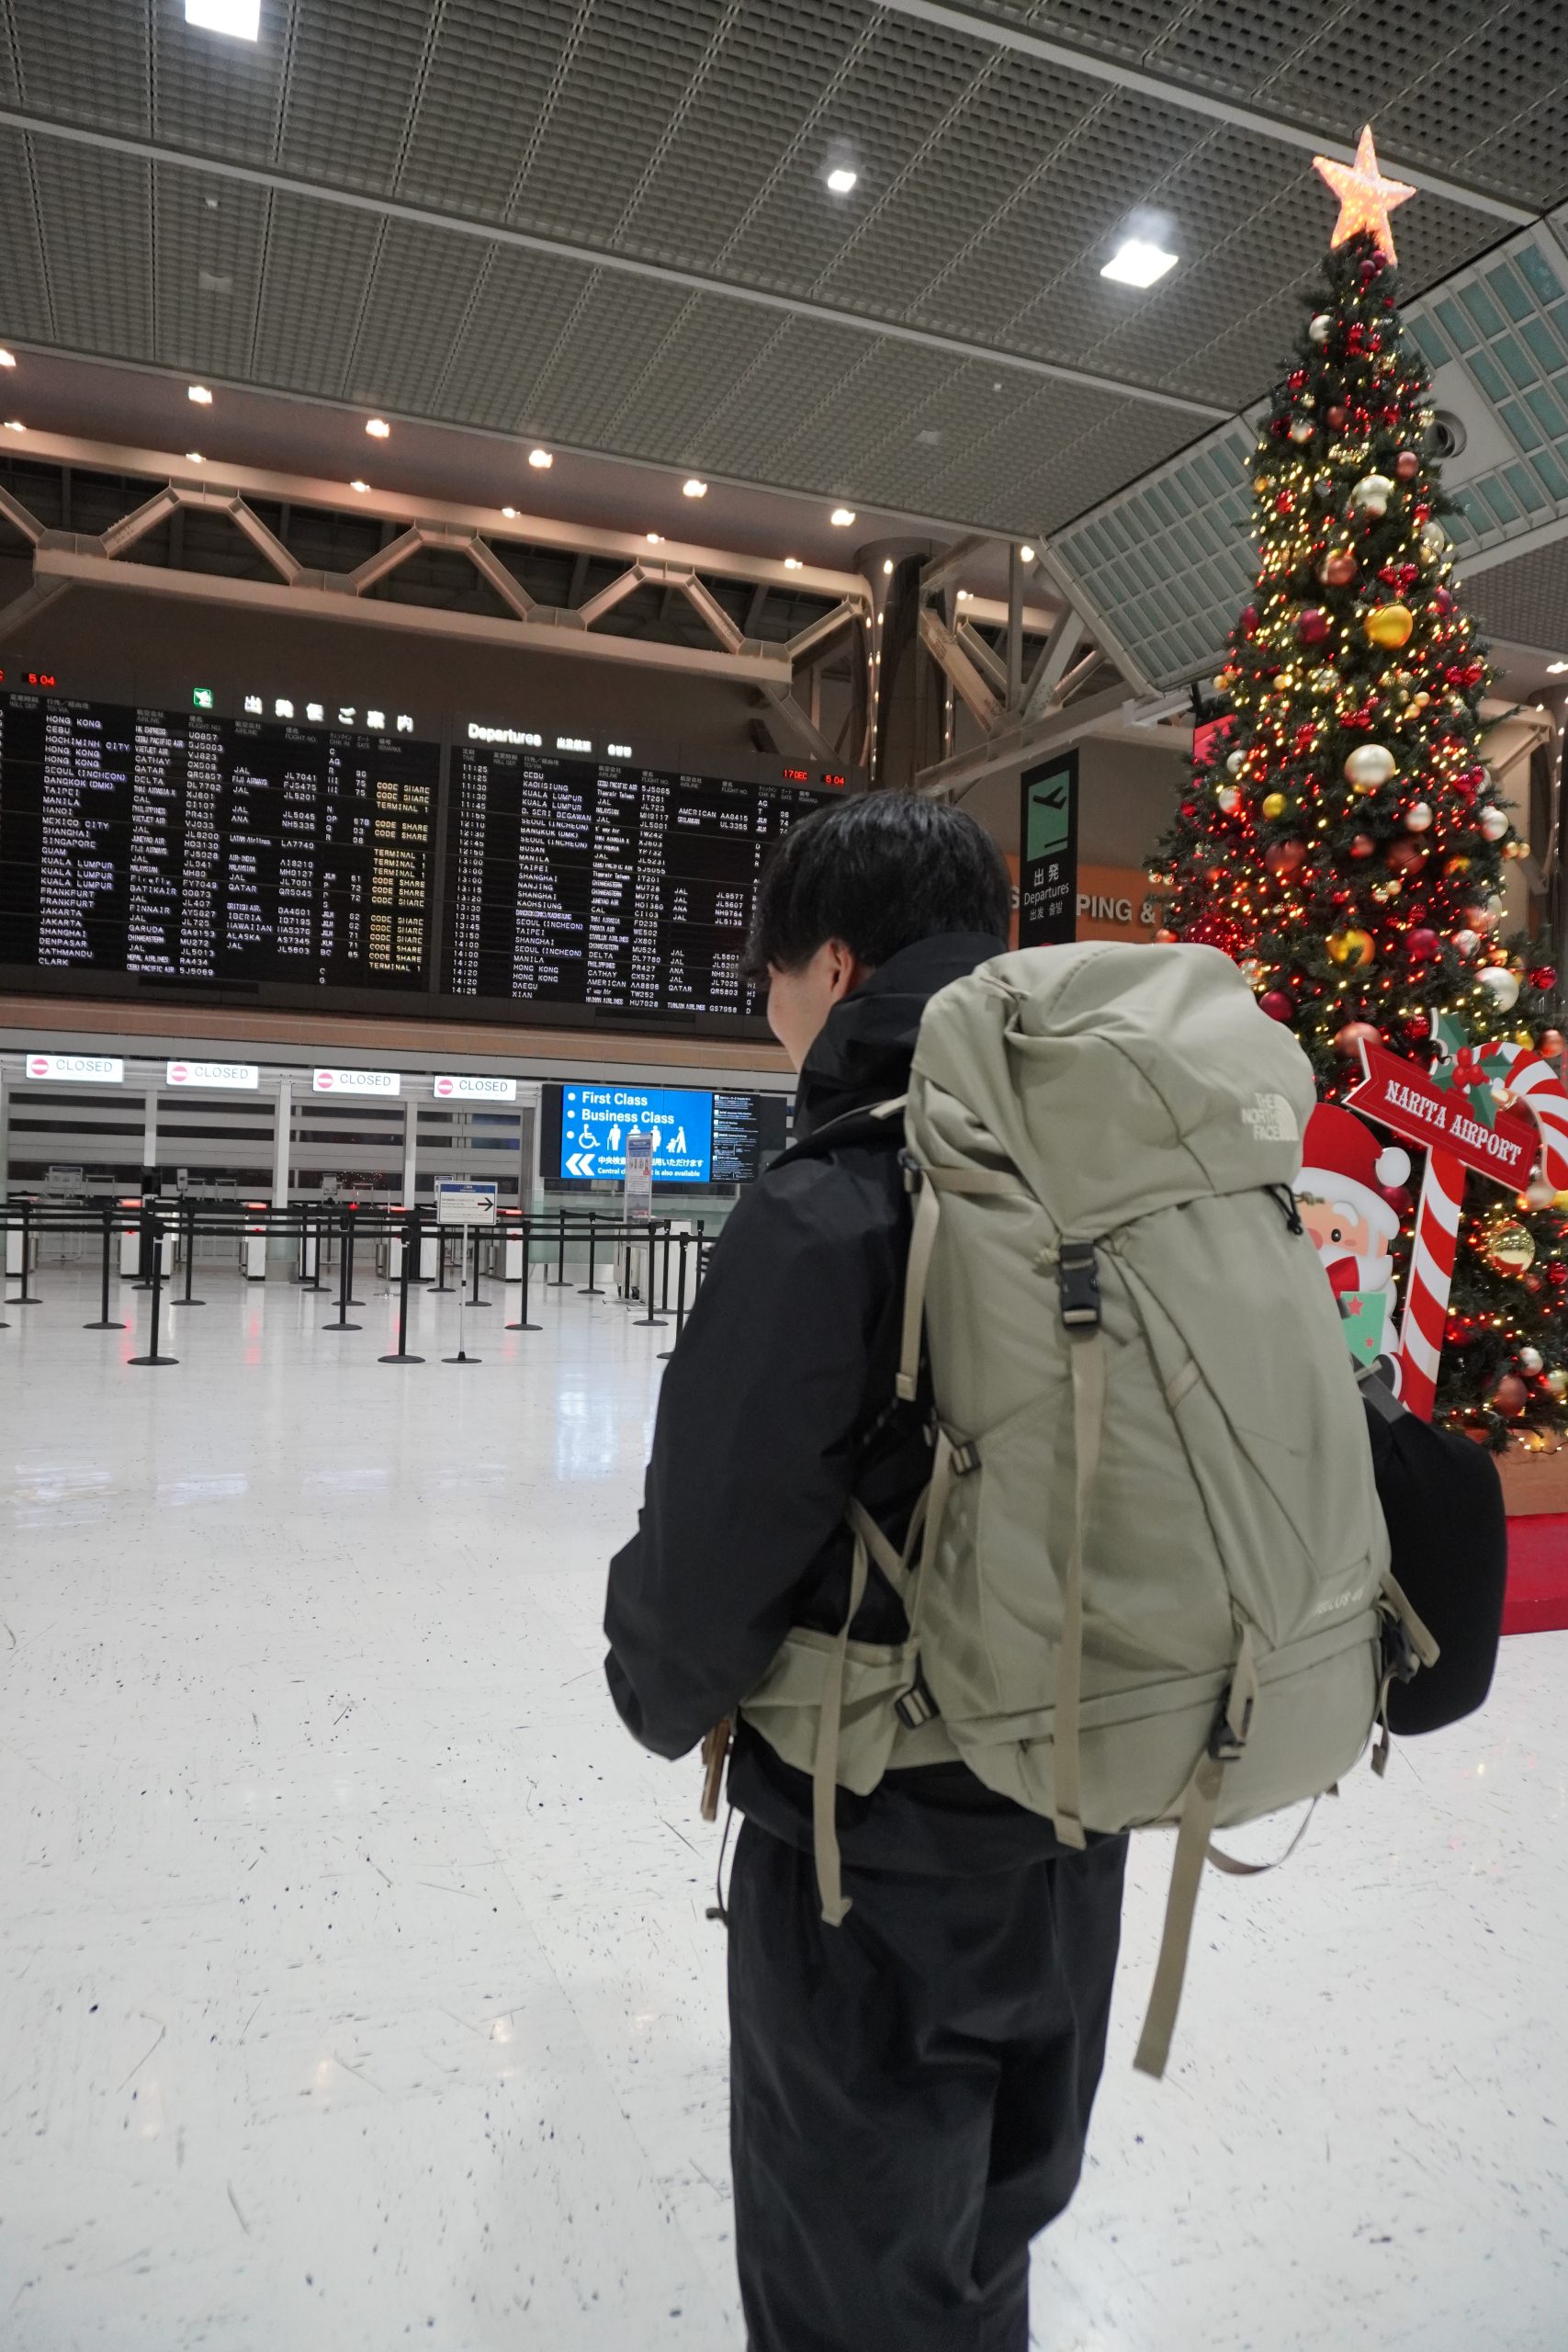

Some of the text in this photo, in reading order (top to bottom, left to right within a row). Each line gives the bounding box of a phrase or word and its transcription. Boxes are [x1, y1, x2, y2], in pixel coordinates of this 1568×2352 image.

[46, 716, 101, 729] HONG KONG
[46, 726, 70, 734] CEBU
[468, 722, 543, 748] Departures
[106, 742, 130, 751] CITY
[45, 746, 100, 758] HONG KONG
[45, 756, 100, 768] HONG KONG
[135, 755, 170, 764] CATHAY
[135, 765, 164, 775] QATAR
[523, 790, 547, 798] KUALA
[43, 797, 80, 807] MANILA
[42, 817, 108, 829] MEXICO CITY
[375, 820, 428, 832] CODE SHARE
[374, 848, 415, 859] TERMINAL
[41, 857, 113, 869] KUALA LUMPUR
[519, 864, 547, 872] TAIPEI
[41, 867, 113, 879] KUALA LUMPUR
[519, 873, 558, 882] SHANGHAI
[1033, 863, 1059, 888] 出発
[77, 881, 112, 889] LUMPUR
[229, 884, 256, 892] QATAR
[518, 882, 553, 891] NANJING
[40, 888, 94, 898] FRANKFURT
[518, 891, 557, 900] SHANGHAI
[1024, 882, 1069, 906] Departures
[40, 897, 94, 908] FRANKFURT
[517, 900, 562, 910] KAOHSIUNG
[40, 908, 82, 917] JAKARTA
[40, 919, 82, 927] JAKARTA
[39, 927, 85, 937] SHANGHAI
[129, 924, 164, 933] GARUDA
[516, 927, 545, 935] TAIPEI
[39, 937, 87, 947] DENPASAR
[227, 933, 260, 941] ALASKA
[39, 948, 93, 957] KATHMANDU
[397, 945, 422, 954] SHARE
[39, 957, 68, 966] CLARK
[56, 1058, 113, 1072] CLOSED
[194, 1066, 249, 1080] CLOSED
[340, 1073, 391, 1087] CLOSED
[459, 1080, 508, 1092] CLOSED
[582, 1091, 649, 1106] First Class
[1255, 1092, 1276, 1109] THE
[581, 1108, 675, 1125] Business Class
[1384, 1079, 1523, 1166] NARITA AIRPORT
[1253, 1124, 1280, 1141] FACE
[597, 1167, 620, 1175] Central
